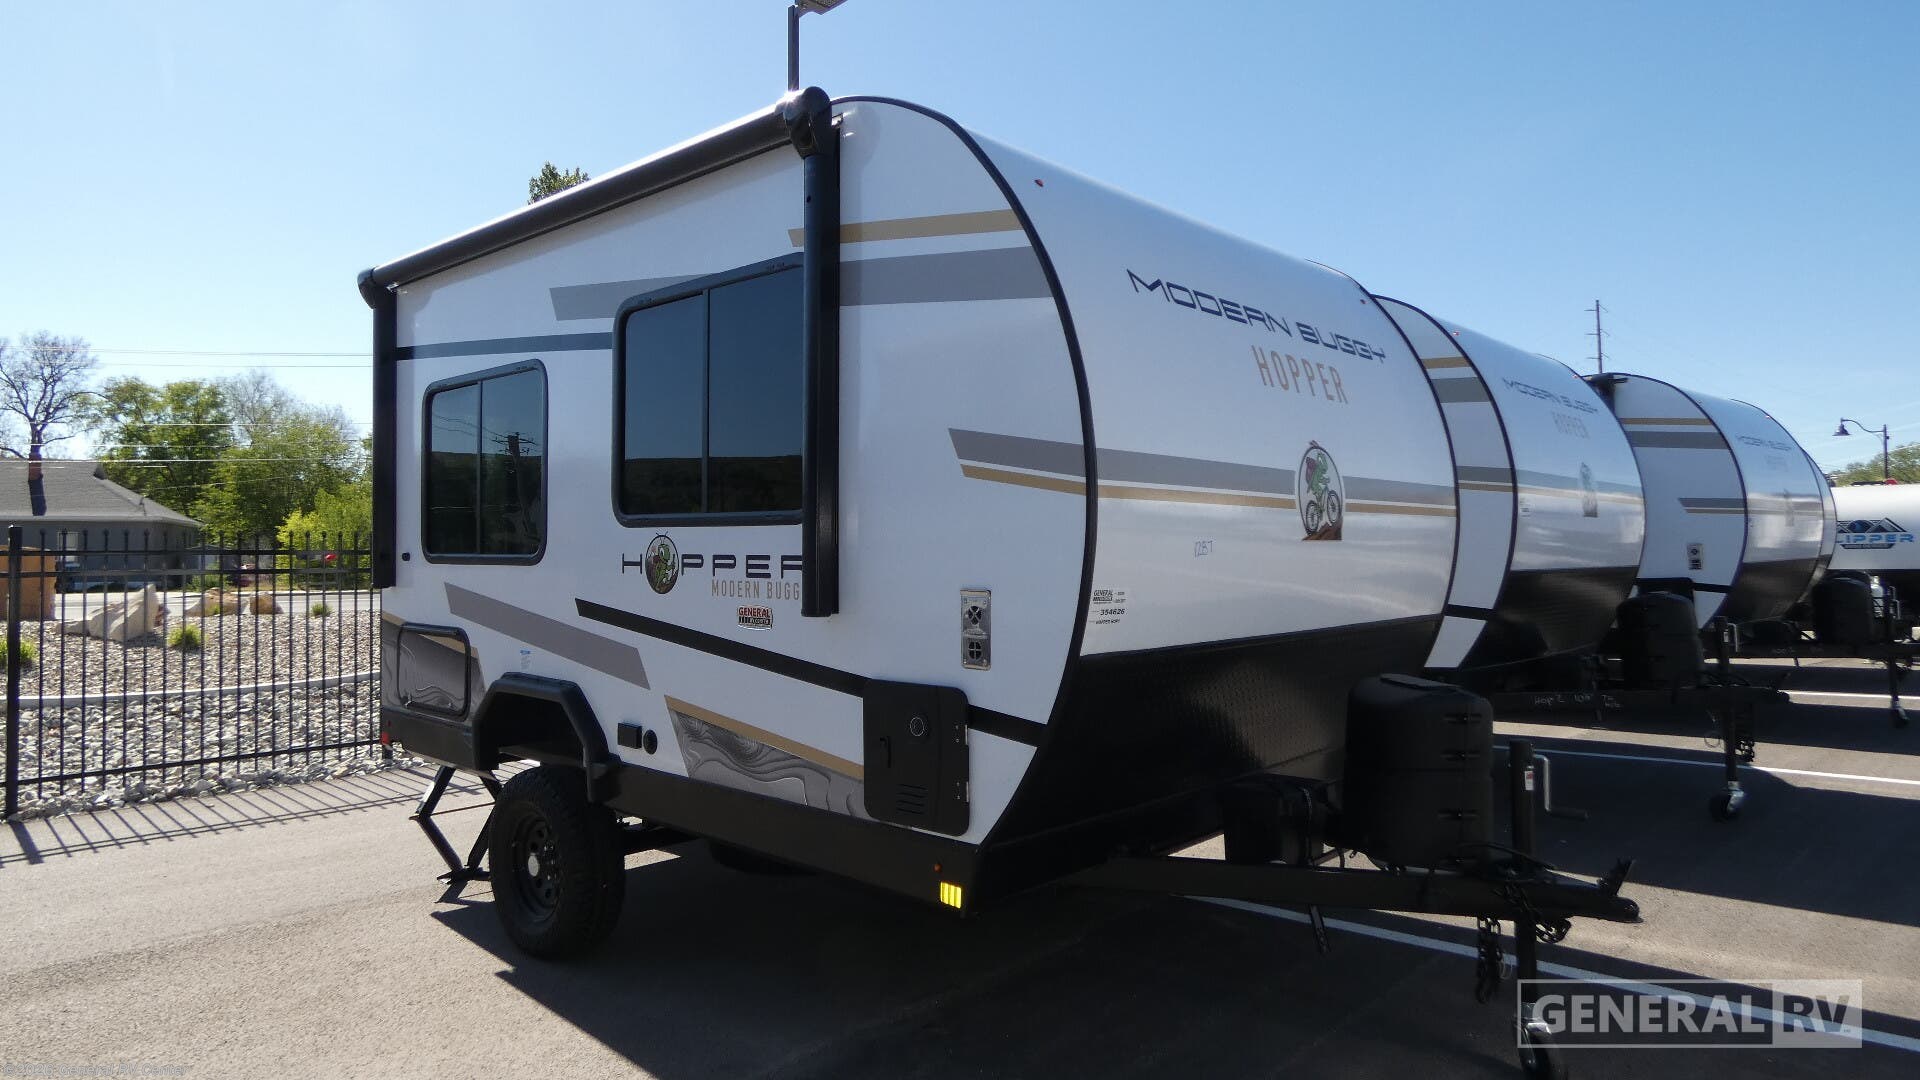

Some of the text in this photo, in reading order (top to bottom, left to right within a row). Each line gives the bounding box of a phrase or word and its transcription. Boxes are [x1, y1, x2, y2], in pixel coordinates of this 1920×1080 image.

[1126, 268, 1387, 364] MODERN BUGGY
[1251, 344, 1349, 405] HOPPER
[711, 579, 800, 601] MODERN BUGG
[738, 606, 771, 618] GENERAL
[1100, 608, 1126, 616] 354626
